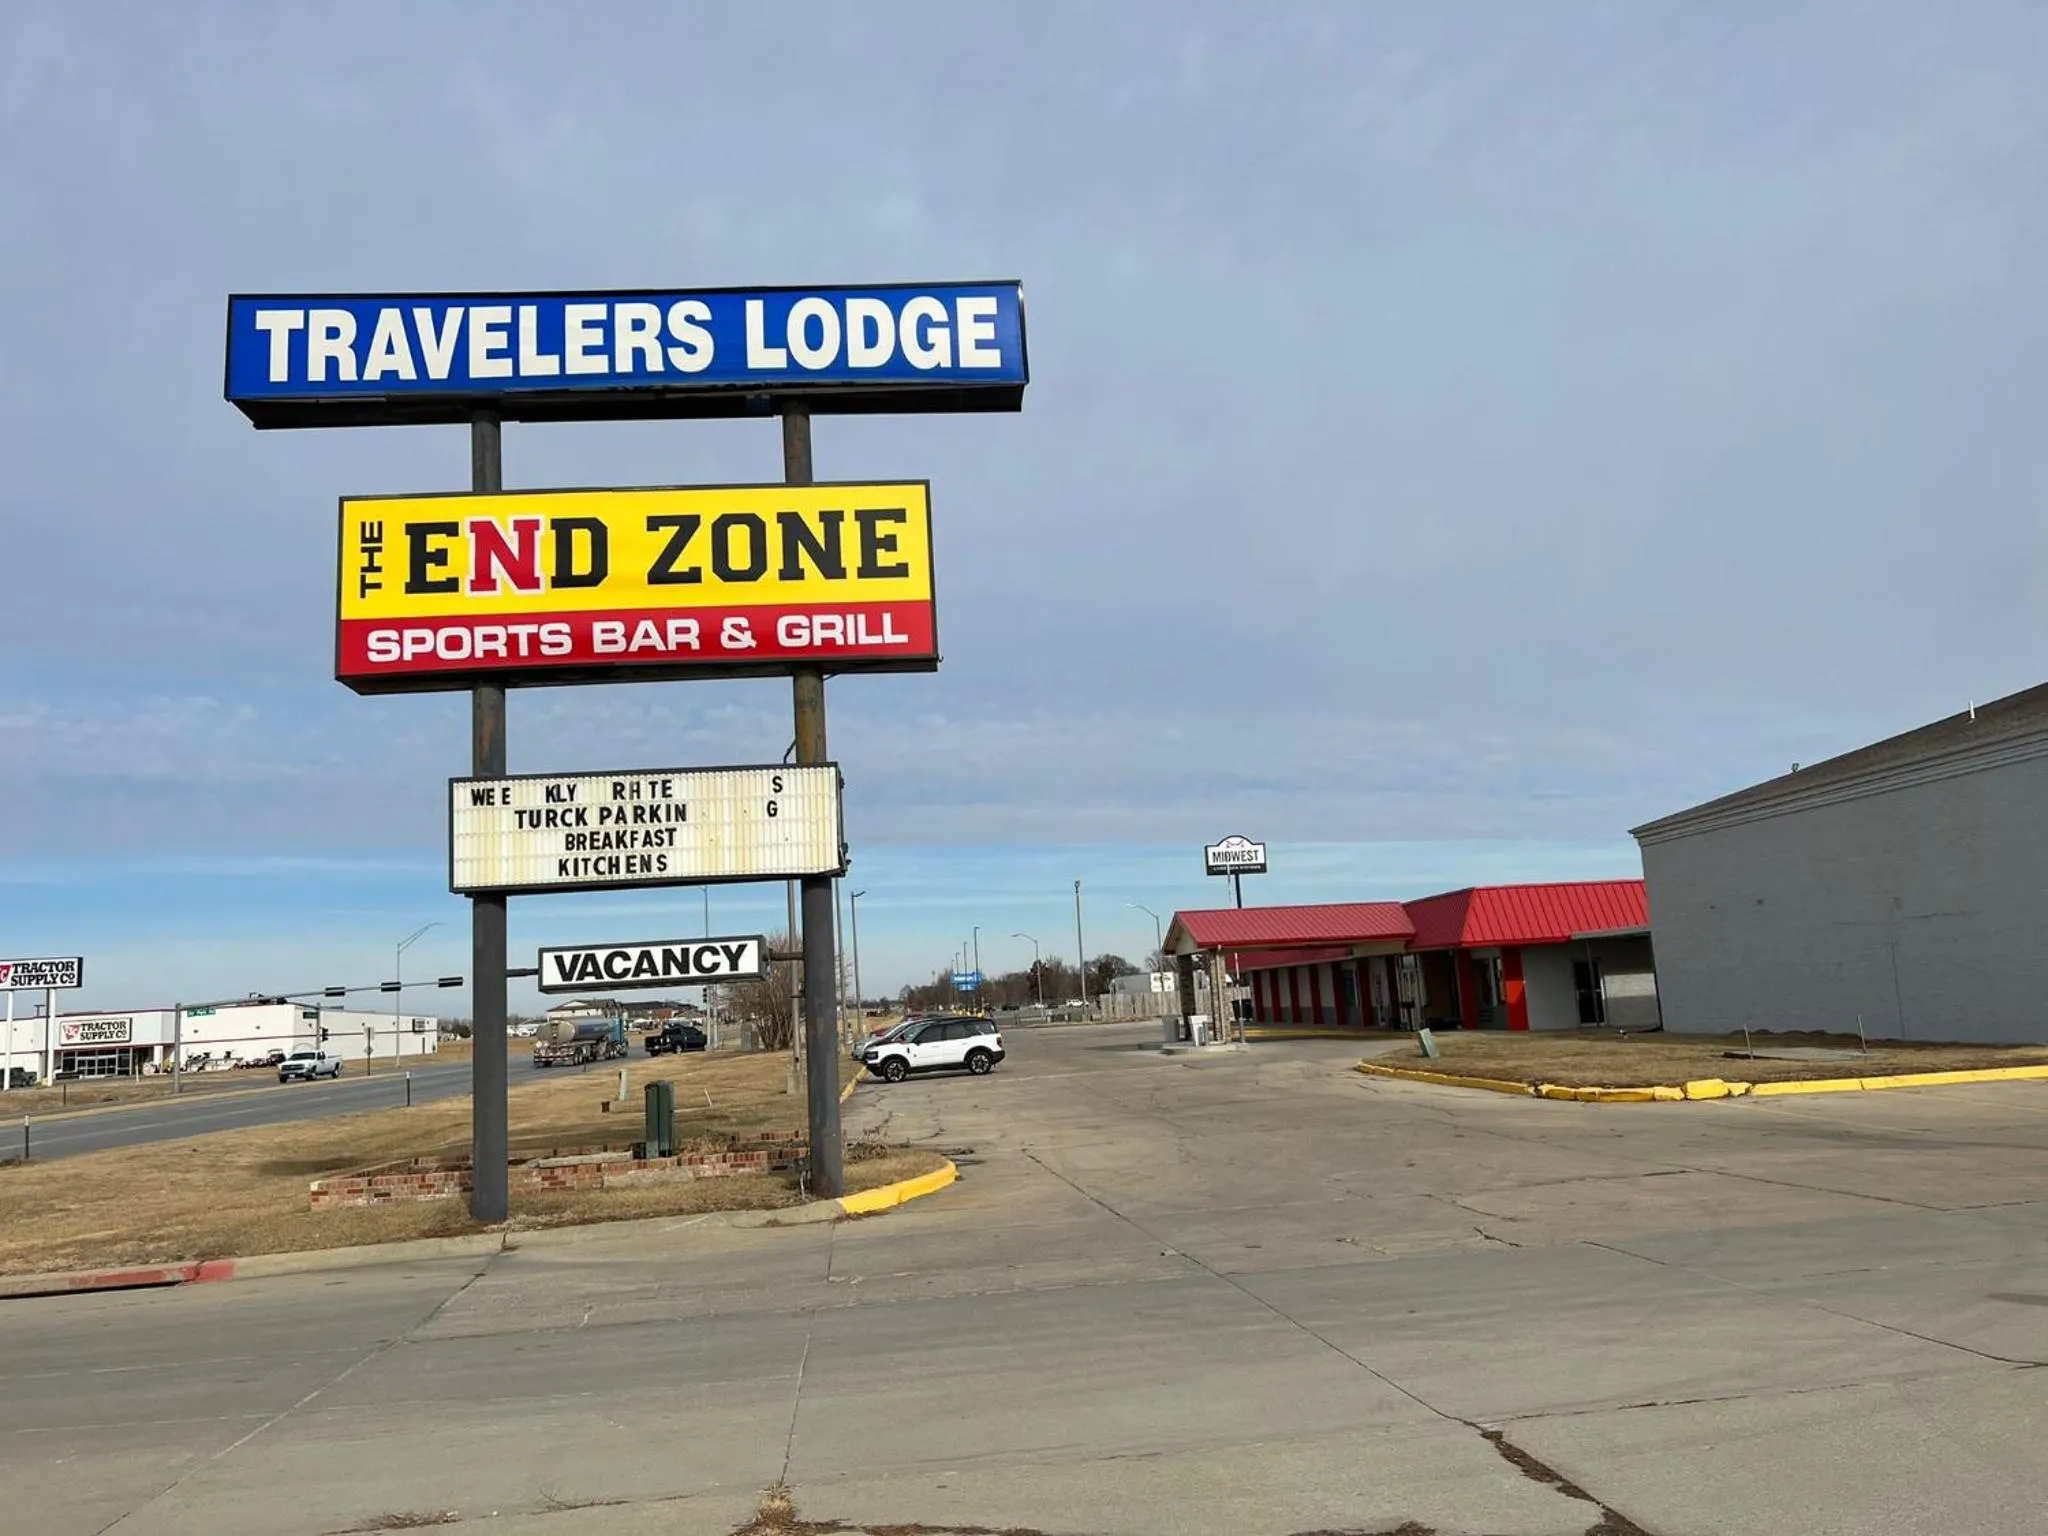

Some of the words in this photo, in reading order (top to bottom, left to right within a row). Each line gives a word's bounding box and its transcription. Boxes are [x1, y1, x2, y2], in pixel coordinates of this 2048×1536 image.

[255, 301, 714, 383] TRAVELERS
[746, 297, 1002, 371] LODGE
[360, 521, 383, 598] THE
[404, 516, 608, 595] END
[646, 508, 909, 585] ZONE
[367, 623, 573, 663] SPORTS
[593, 618, 700, 654] BAR
[720, 617, 757, 648] &
[777, 612, 908, 648] GRILL
[772, 776, 783, 793] S
[514, 807, 588, 829] TURCK
[599, 803, 688, 825] PARKIN
[766, 800, 778, 817] G
[565, 827, 677, 851] BREAKFAST
[558, 854, 667, 876] KITCHENS
[1212, 849, 1259, 863] MIDWEST
[12, 961, 75, 973] TRACTOR
[554, 944, 748, 982] VACANCY
[10, 974, 58, 986] SUPPLY
[80, 1031, 115, 1040] SUPPLY
[81, 1021, 126, 1032] TRACTOR
